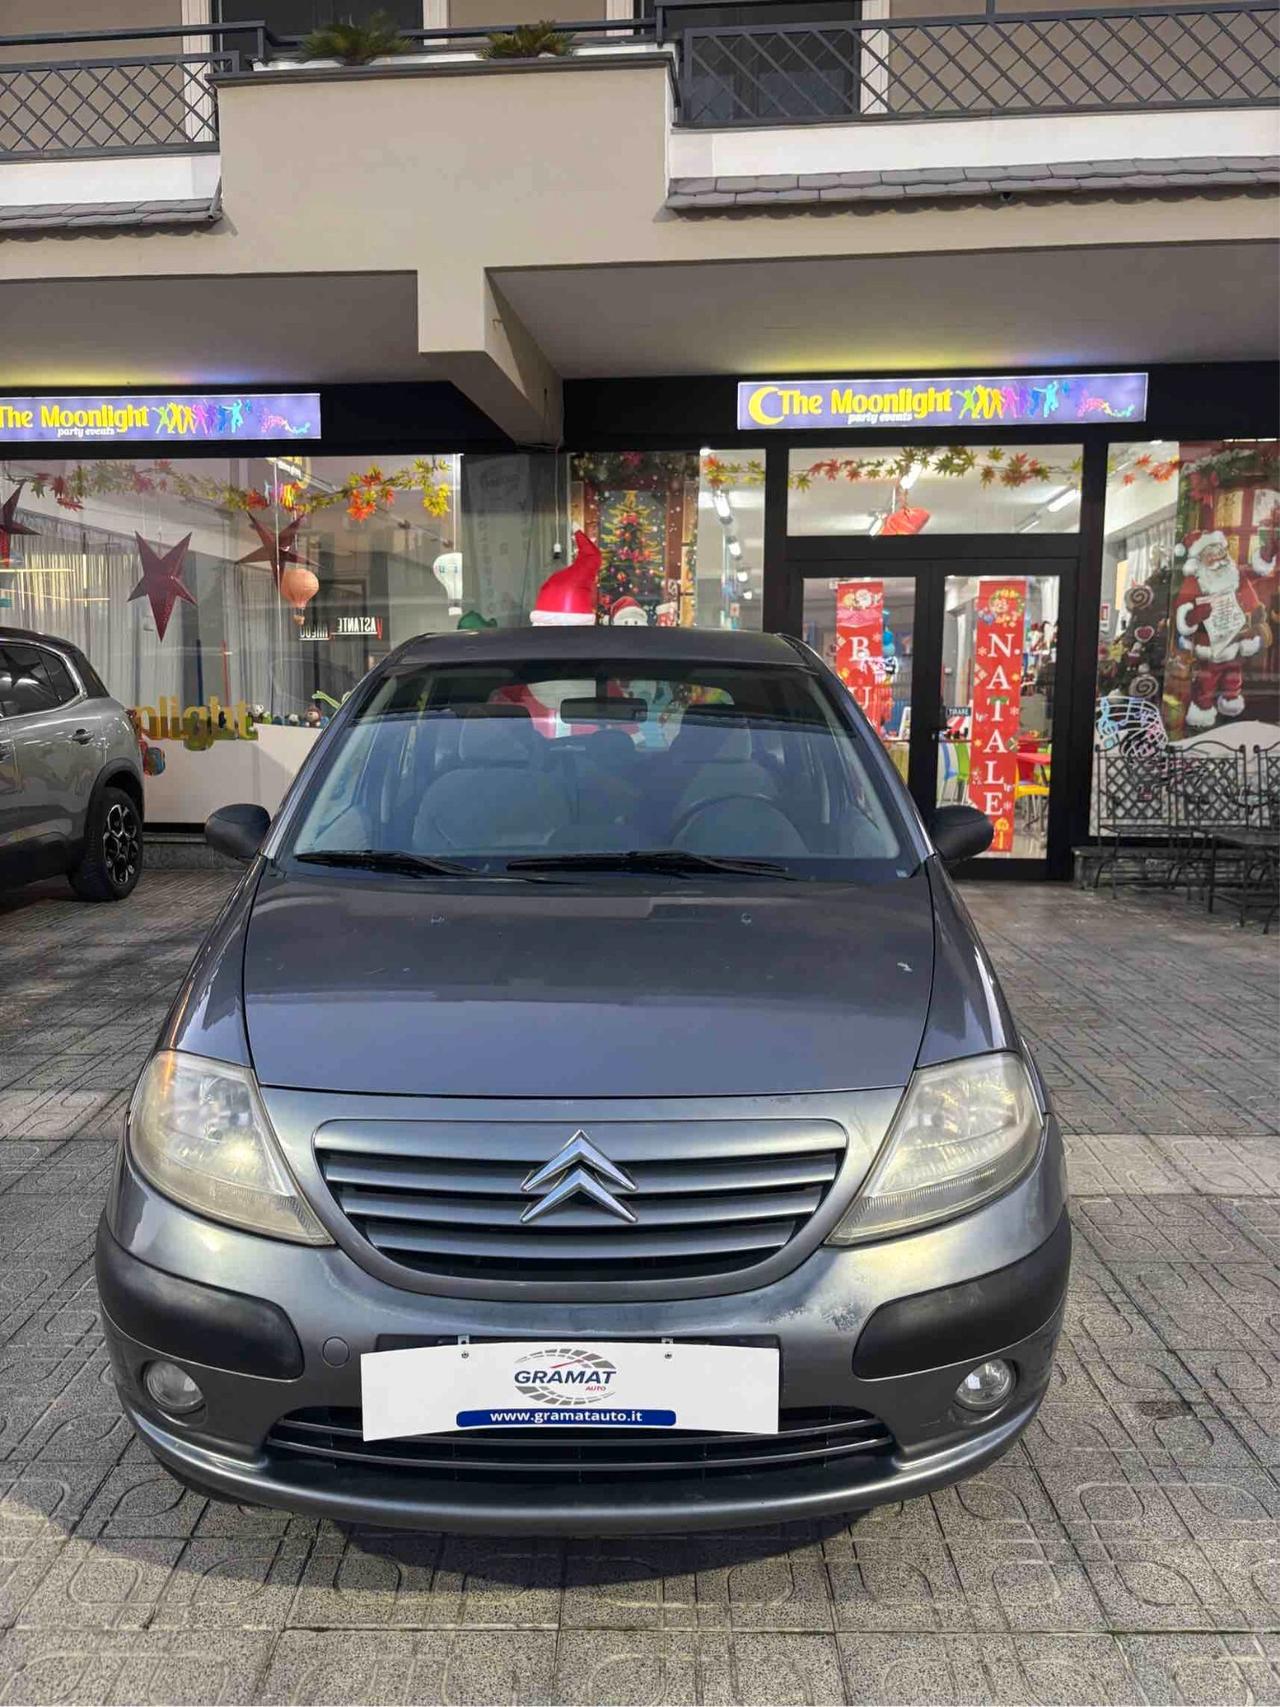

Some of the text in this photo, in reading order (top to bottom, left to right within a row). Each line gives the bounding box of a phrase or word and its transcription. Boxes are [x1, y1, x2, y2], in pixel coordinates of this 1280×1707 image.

[777, 387, 953, 418] The Moonlight
[0, 404, 149, 432] The Moonlight
[848, 413, 912, 424] party events
[57, 427, 115, 437] party events
[514, 1370, 617, 1385] GRAMAT
[585, 1384, 607, 1392] AUTO
[489, 1410, 643, 1424] www.gramatauto.it
